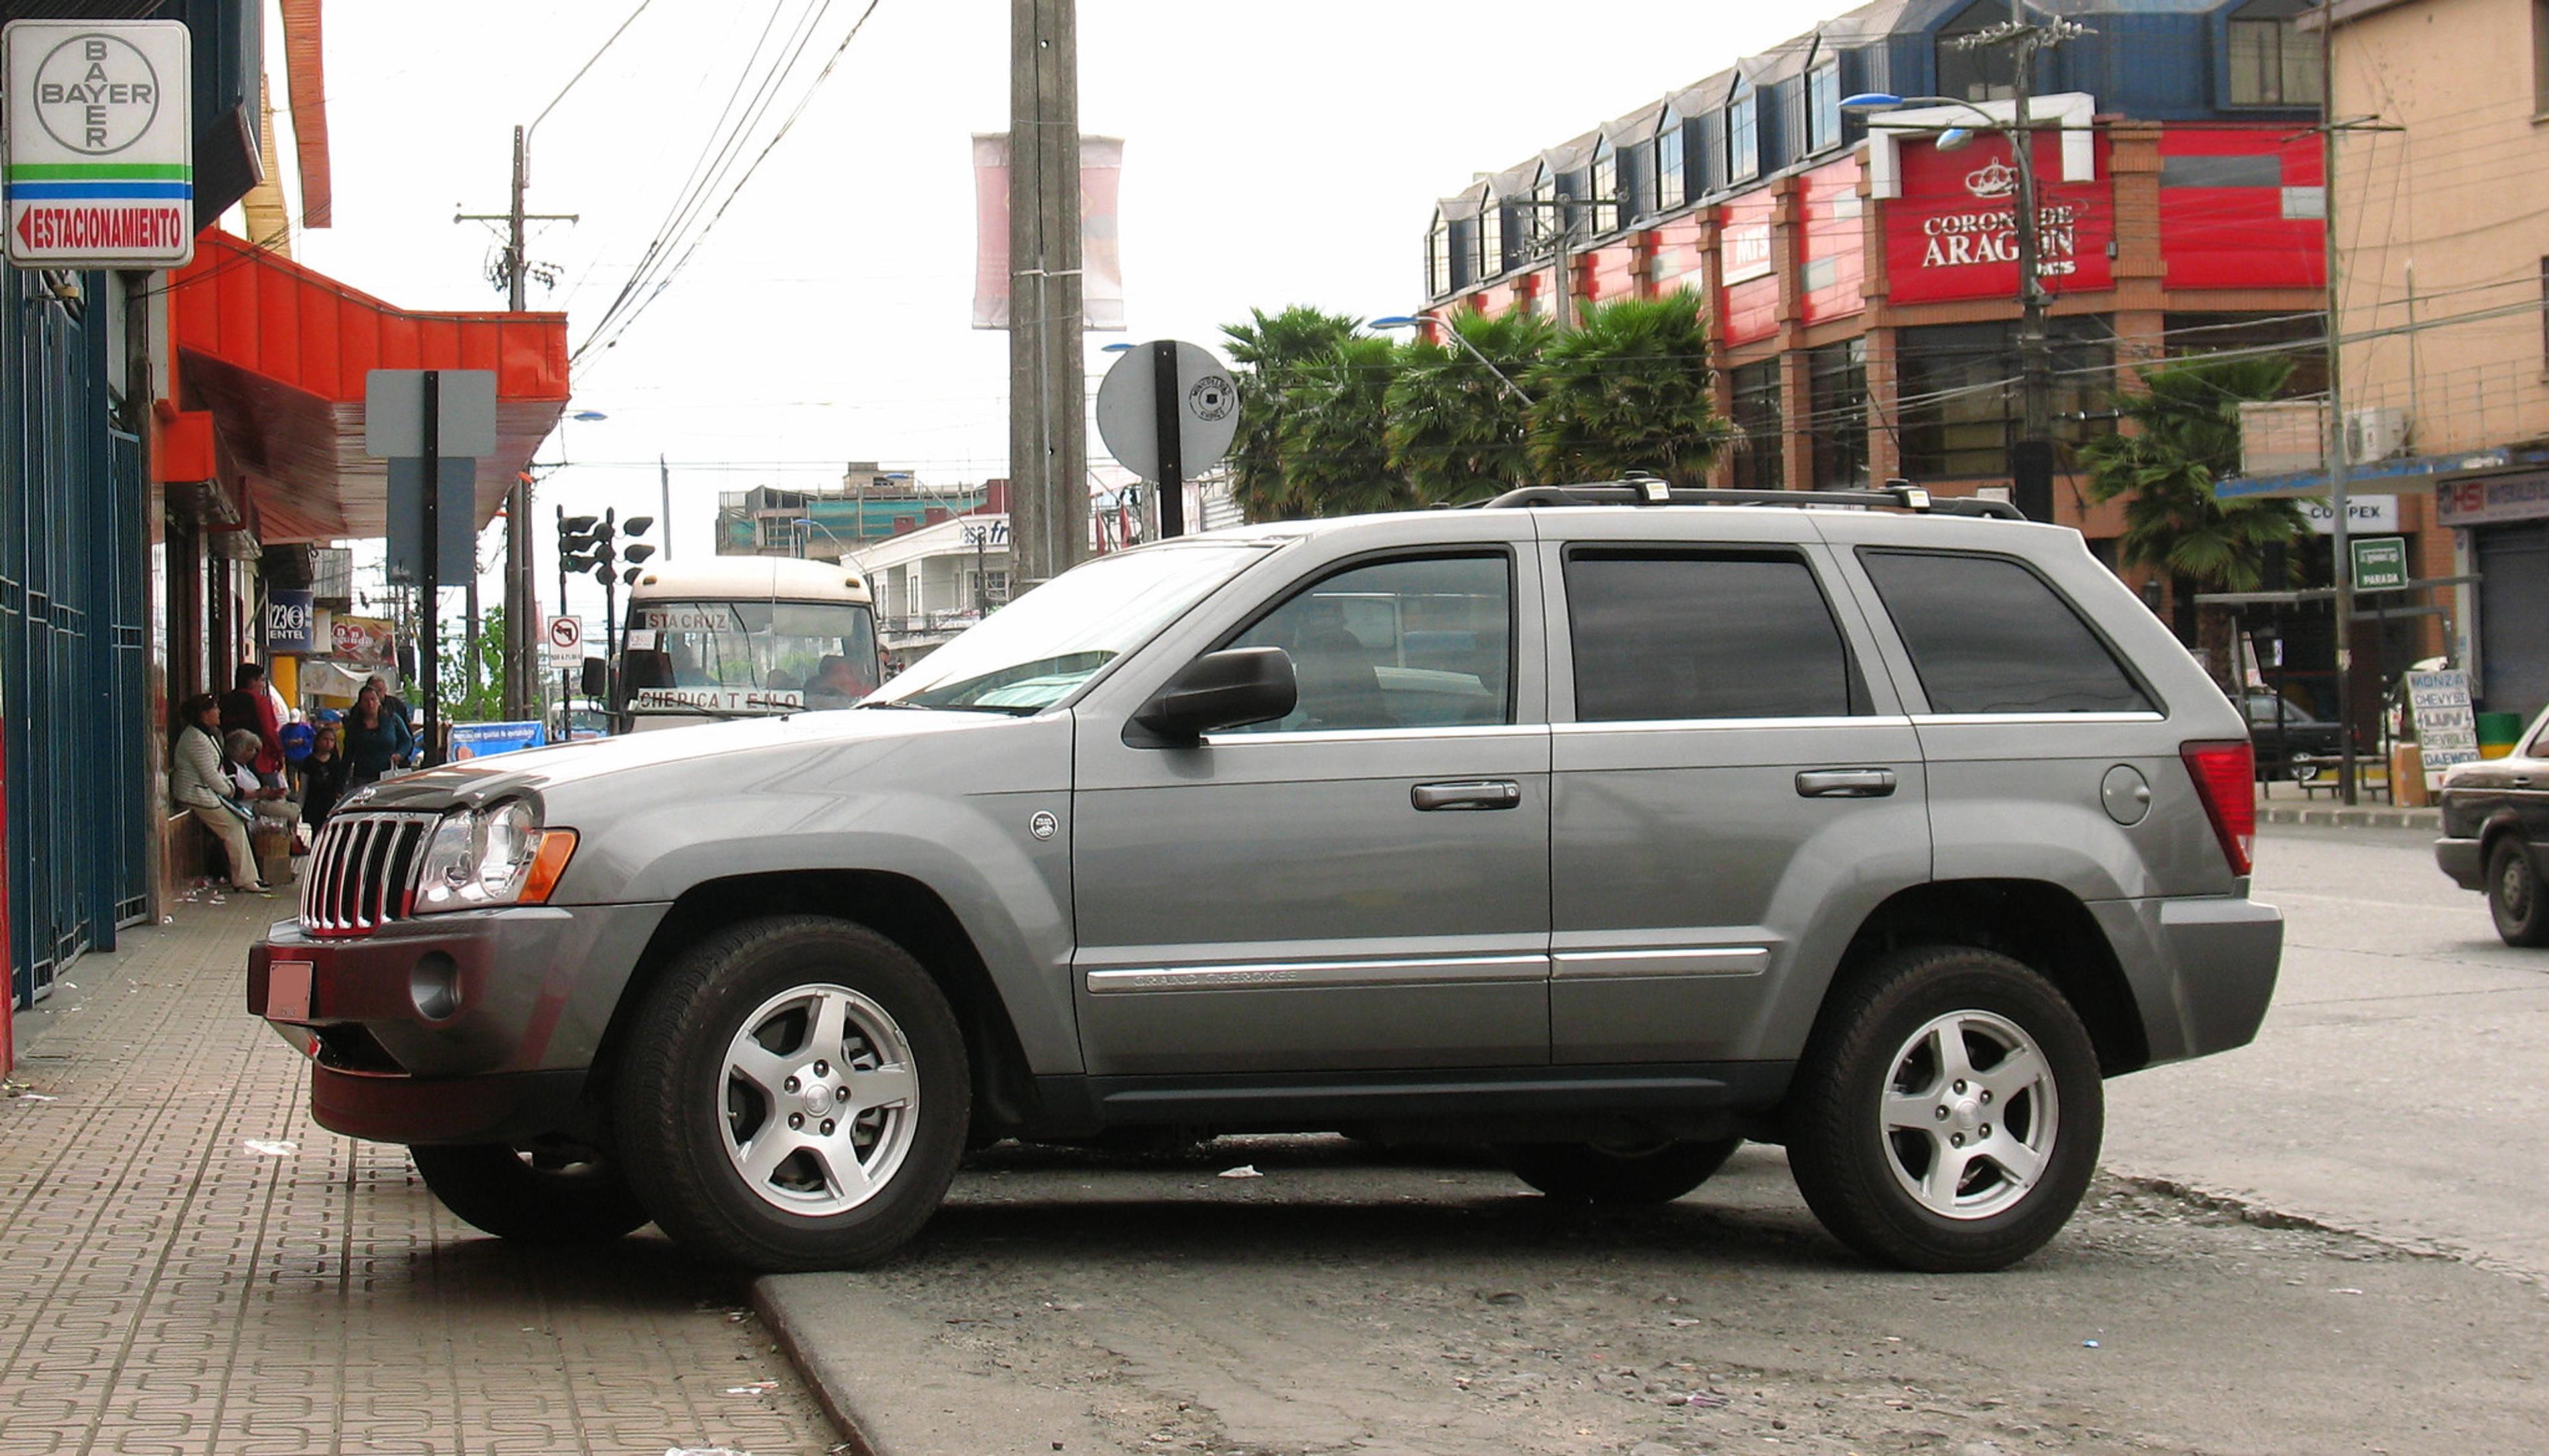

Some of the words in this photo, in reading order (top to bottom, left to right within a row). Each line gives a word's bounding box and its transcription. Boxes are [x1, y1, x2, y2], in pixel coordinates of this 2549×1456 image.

[42, 84, 153, 104] BAYER
[84, 40, 108, 147] BAYER
[35, 208, 181, 249] ESTACIONAMIENTO
[1924, 210, 2015, 236] CORON
[2311, 506, 2380, 518] COPEX
[2364, 573, 2400, 585] PARADA
[682, 614, 726, 629] CRUZ
[270, 630, 305, 640] ENTEL
[1134, 974, 1197, 987] GRAND
[1205, 971, 1298, 984] CHEROKEE
